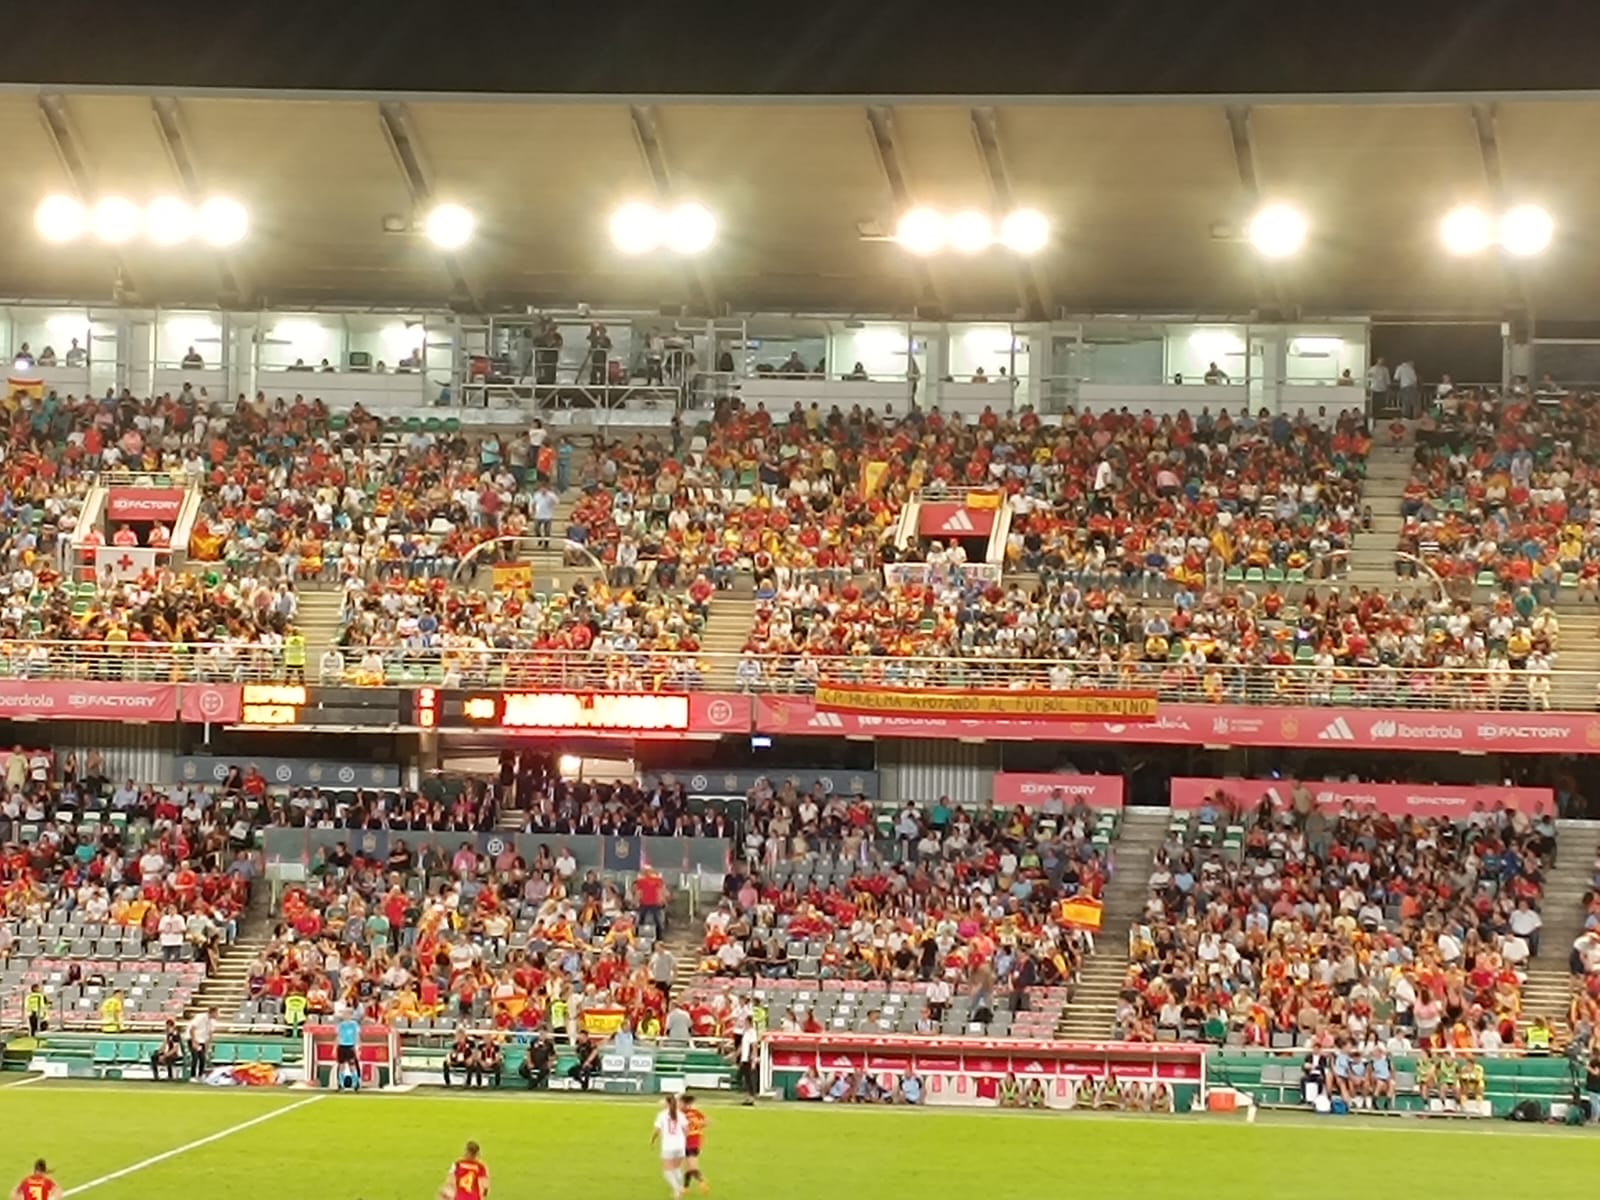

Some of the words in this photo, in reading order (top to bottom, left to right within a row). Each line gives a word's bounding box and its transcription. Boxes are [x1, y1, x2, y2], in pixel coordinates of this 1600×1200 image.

[129, 500, 179, 509] FACTORY
[88, 695, 156, 707] FACTORY
[1077, 699, 1149, 714] FEMENINO
[1399, 723, 1463, 739] Iberdrola
[1499, 726, 1570, 738] FACTORY
[459, 1171, 474, 1192] 4
